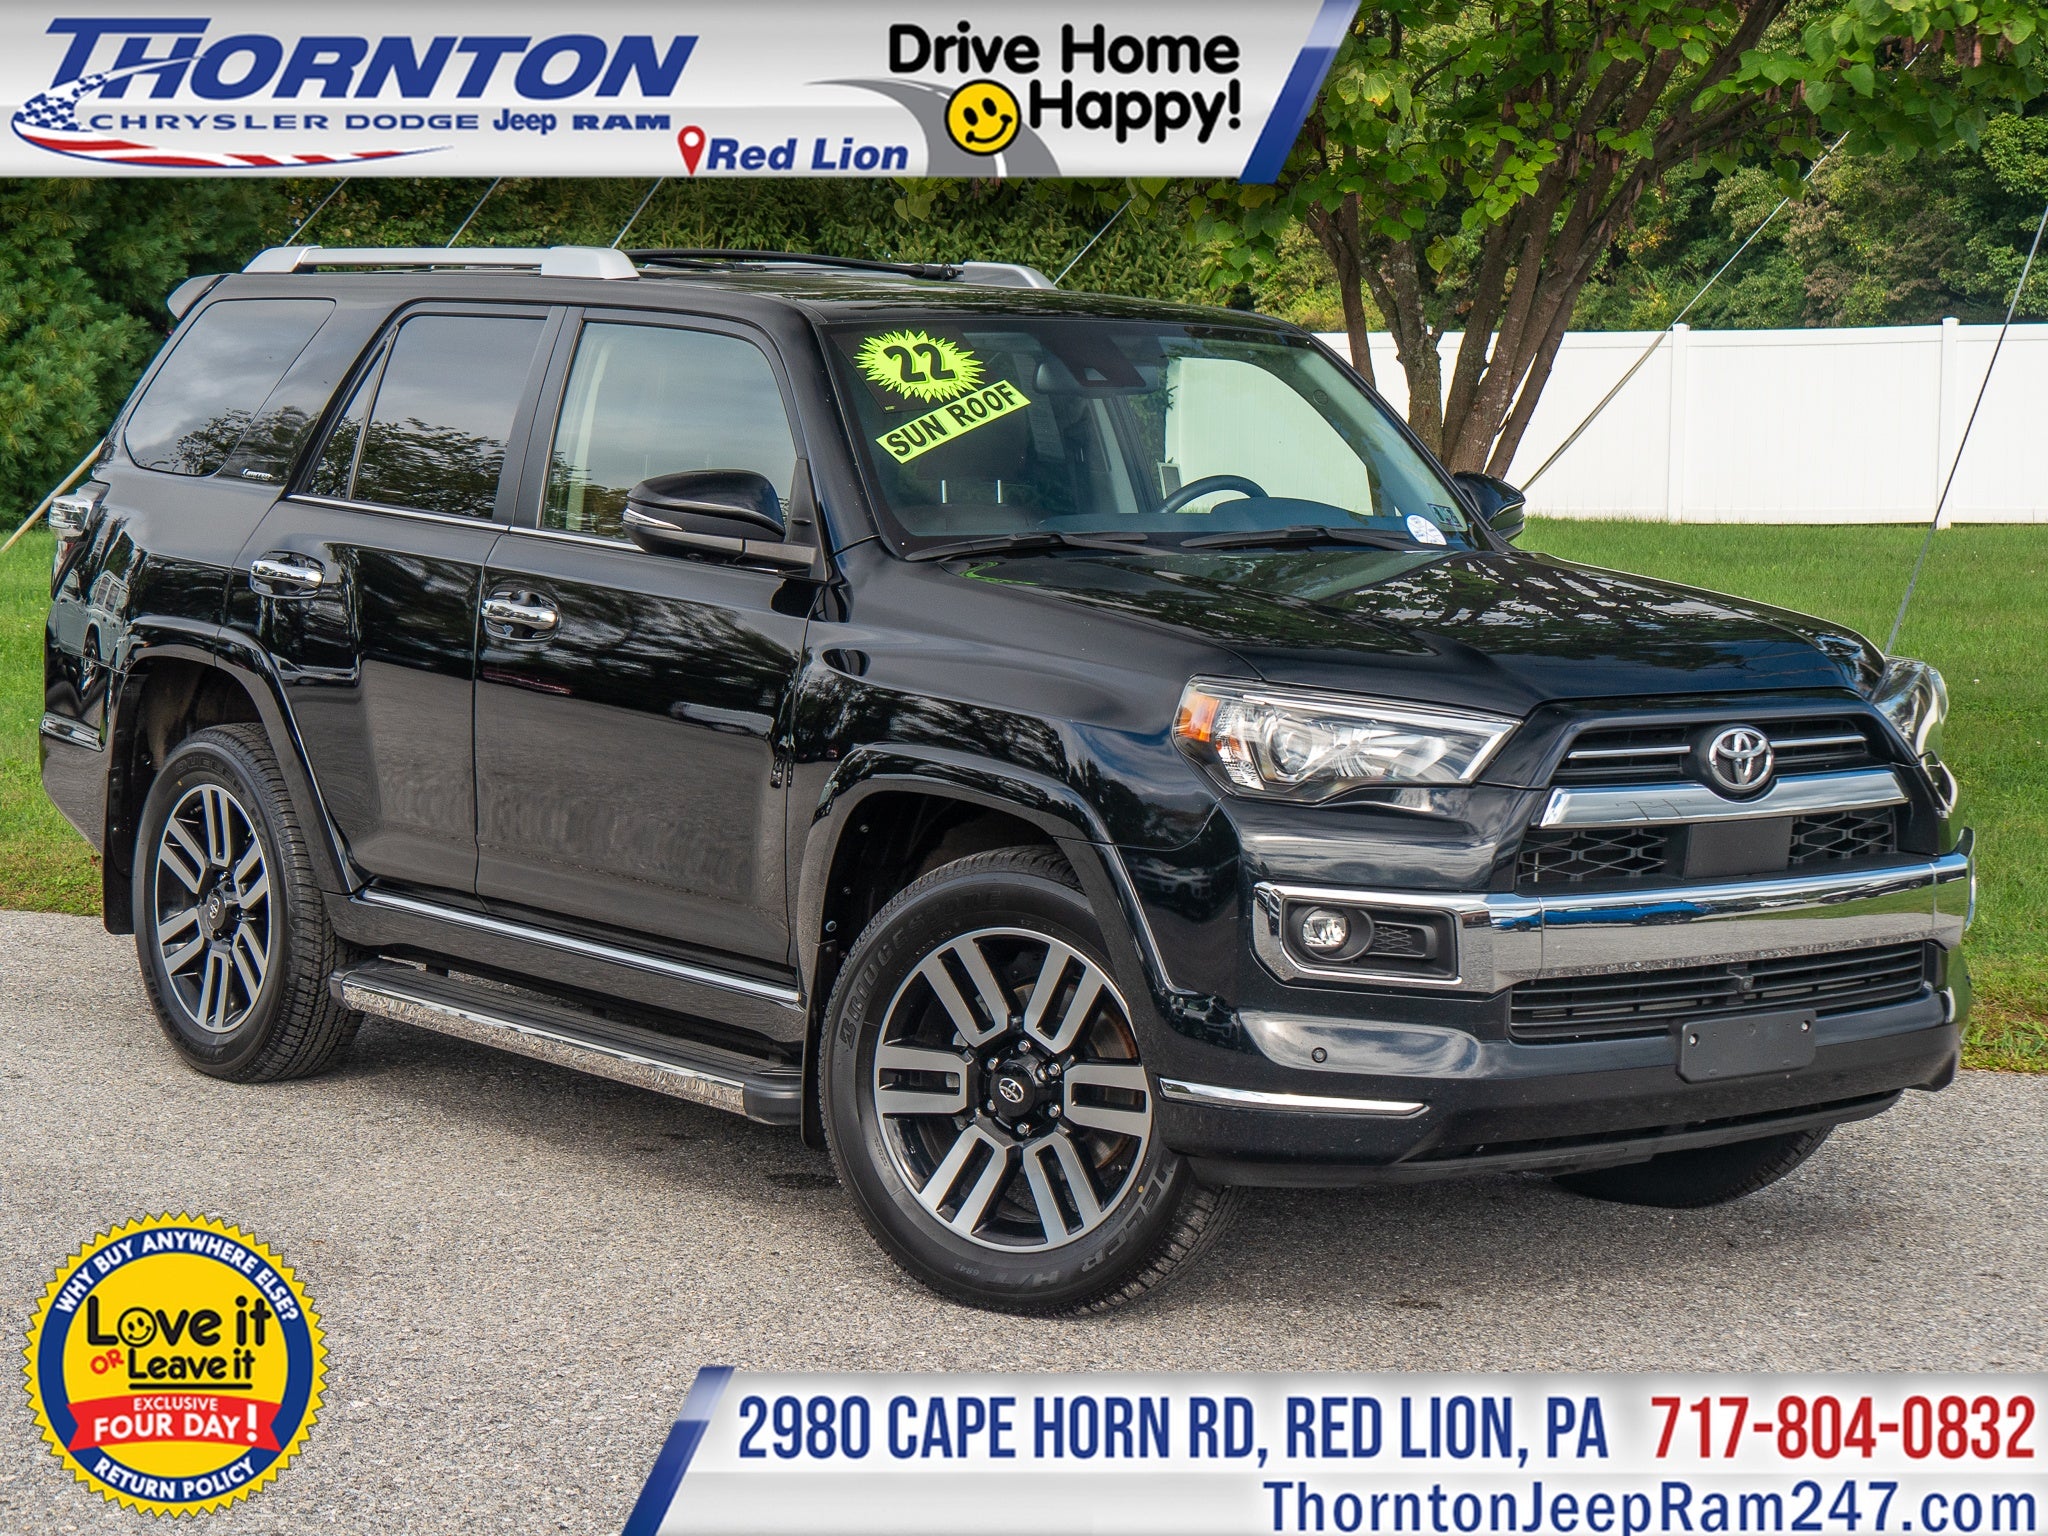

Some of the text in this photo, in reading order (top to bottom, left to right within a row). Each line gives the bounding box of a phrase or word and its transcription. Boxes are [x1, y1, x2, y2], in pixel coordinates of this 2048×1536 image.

[883, 342, 958, 384] 22
[886, 383, 1017, 457] SUN ROOF
